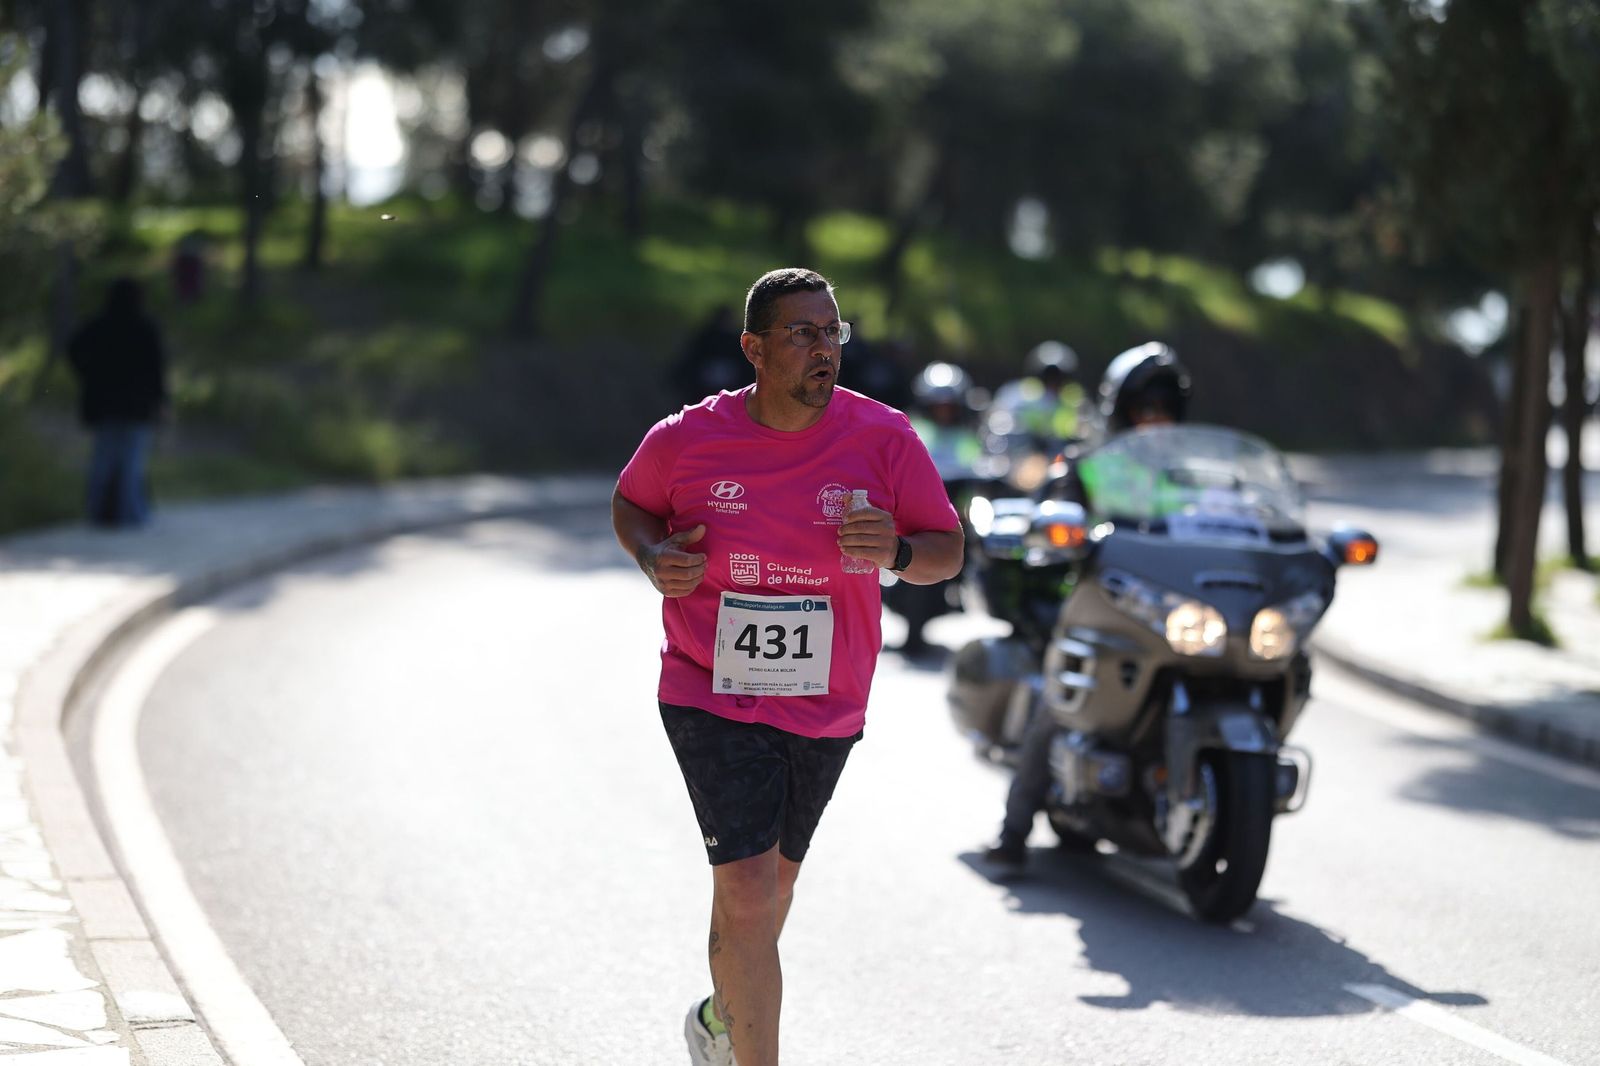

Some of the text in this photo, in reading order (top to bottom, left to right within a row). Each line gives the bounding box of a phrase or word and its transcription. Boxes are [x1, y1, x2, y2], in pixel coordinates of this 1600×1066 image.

[707, 500, 748, 511] HYUNDAI
[767, 562, 812, 575] Ciudad
[767, 573, 829, 586] de Málaga
[734, 624, 813, 660] 431
